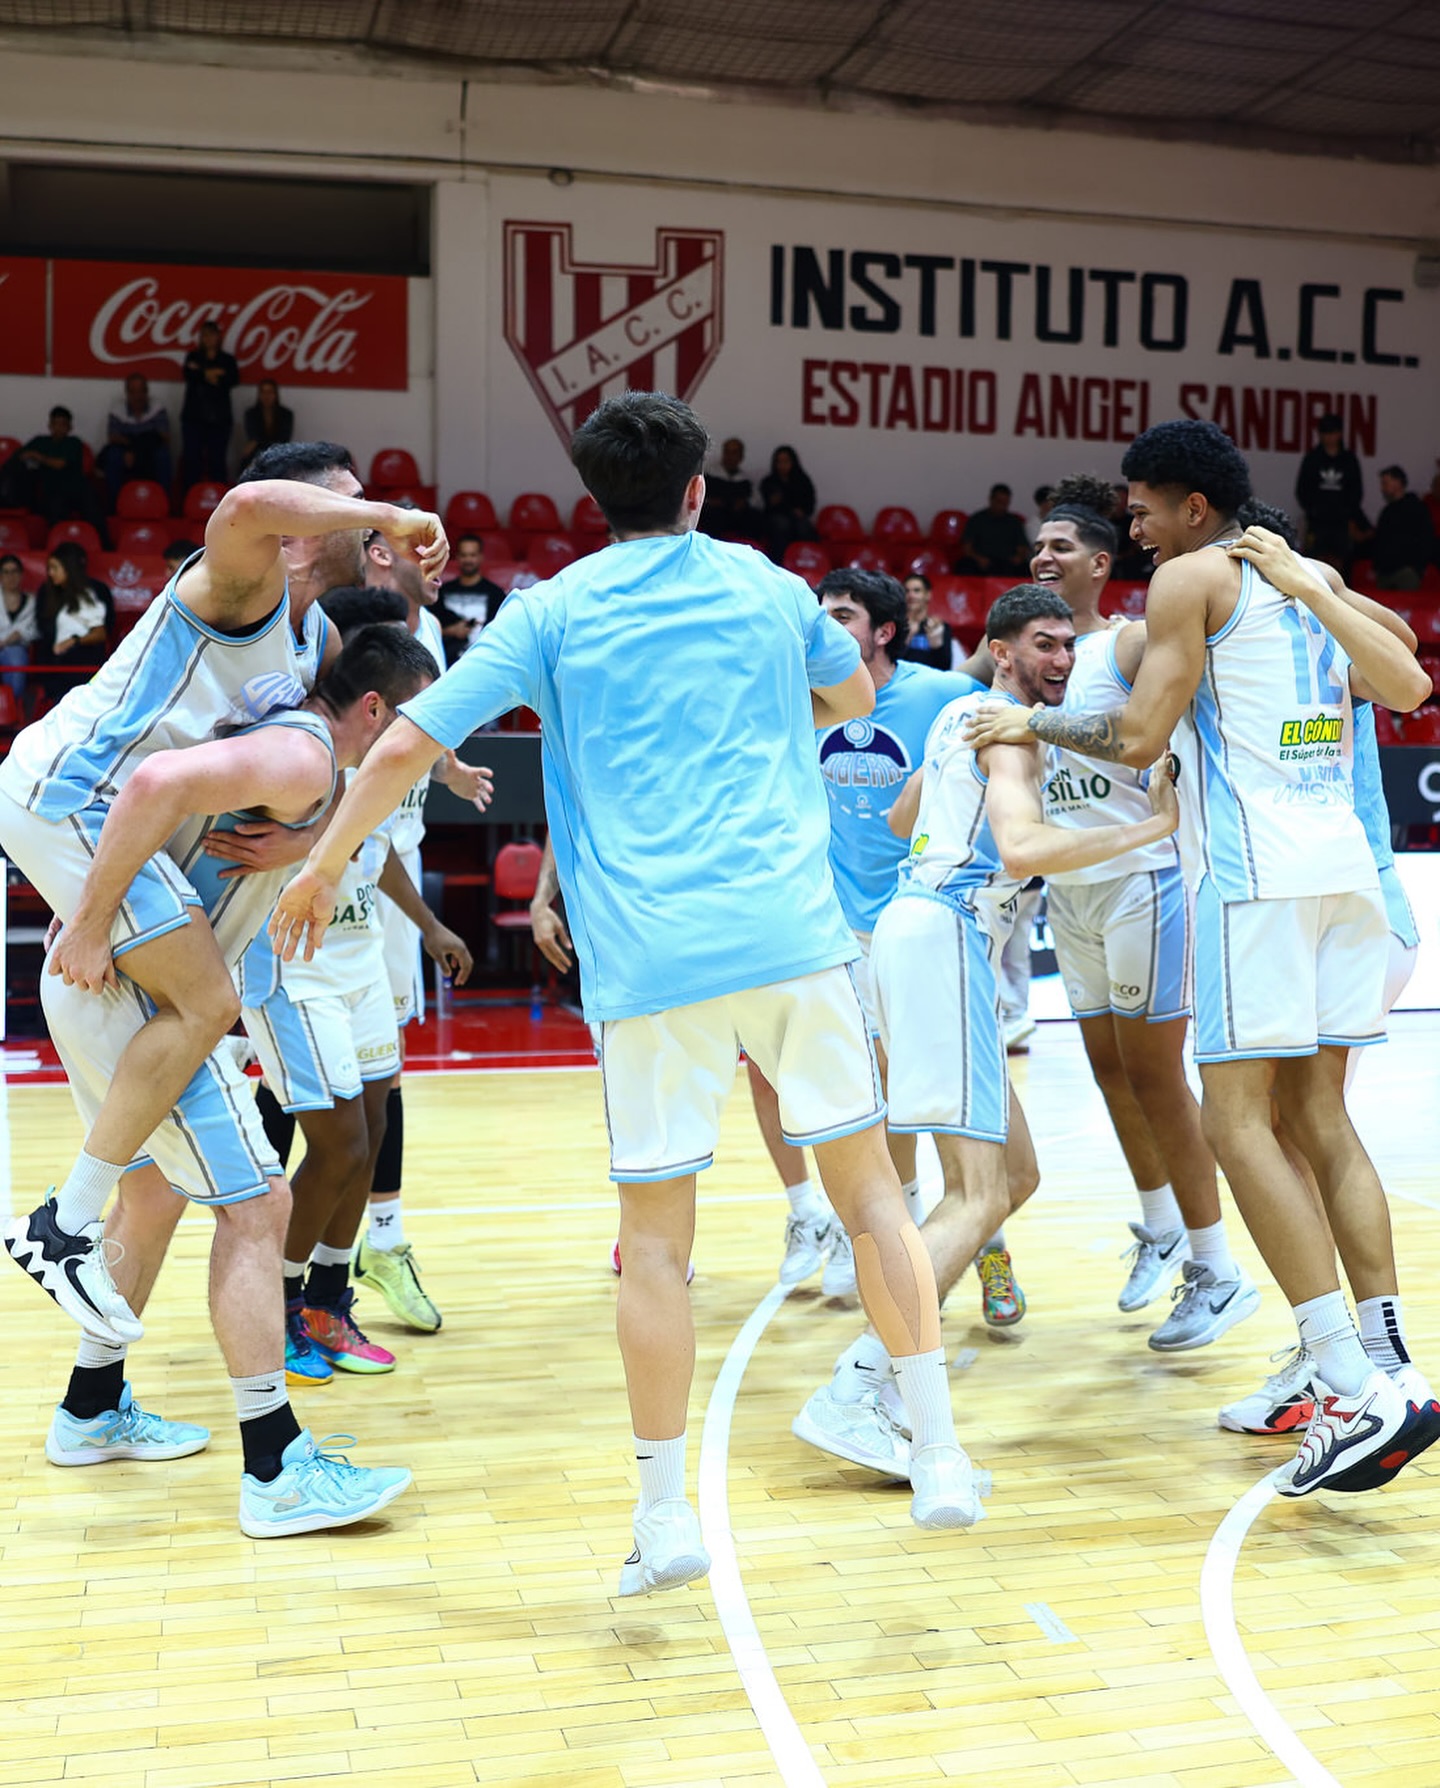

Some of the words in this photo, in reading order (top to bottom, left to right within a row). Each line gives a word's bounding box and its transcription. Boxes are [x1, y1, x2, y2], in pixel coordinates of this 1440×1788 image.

[89, 277, 373, 373] Coca-Cola
[771, 245, 1188, 352] INSTITUTO
[1218, 279, 1419, 369] A.C.C.
[803, 359, 997, 436] ESTADIO
[1279, 606, 1344, 705] 12
[1279, 749, 1290, 760] El
[1280, 720, 1302, 747] EL
[1303, 713, 1344, 744] CÓND
[1047, 773, 1111, 803] SILIO
